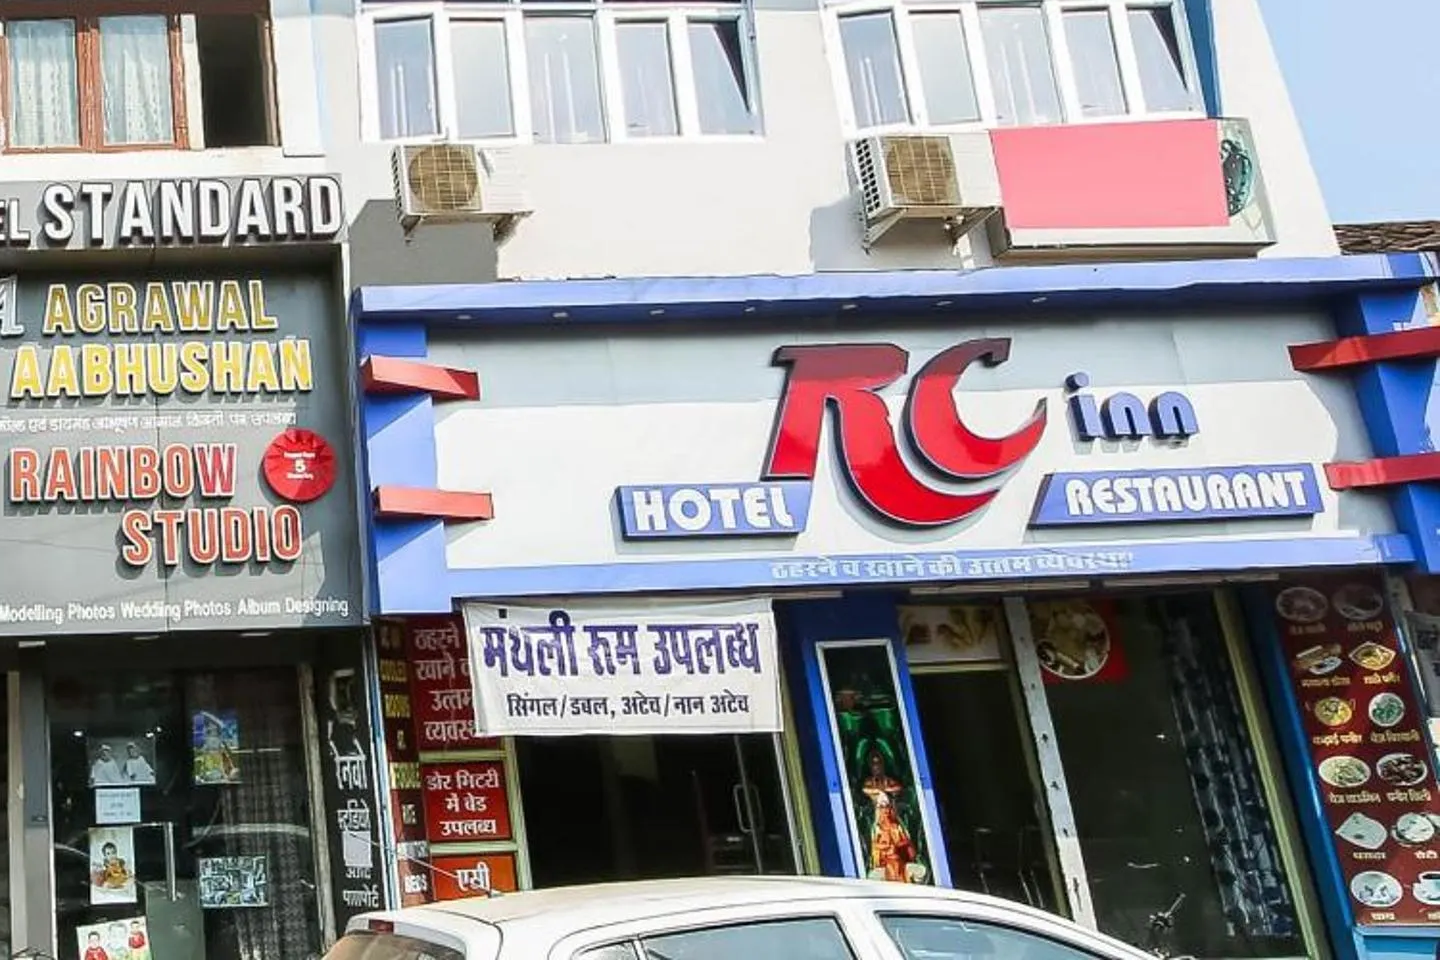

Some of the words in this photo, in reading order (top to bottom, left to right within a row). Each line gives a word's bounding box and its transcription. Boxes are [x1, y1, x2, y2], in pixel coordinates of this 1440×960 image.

[42, 178, 343, 241] STANDARD
[42, 279, 279, 334] AGRAWAL
[10, 339, 313, 399] AABHUSHAN
[1064, 372, 1200, 442] inn
[761, 338, 1048, 529] RC
[10, 443, 236, 504] RAINBOW
[1066, 471, 1310, 516] RESTAURANT
[631, 486, 795, 532] HOTEL
[122, 504, 304, 567] STUDIO
[771, 555, 838, 579] ठहरने
[864, 554, 925, 578] खाने
[928, 553, 962, 577] की
[67, 601, 116, 622] Photos
[120, 600, 182, 622] Wedding
[184, 598, 232, 619] Photos
[237, 597, 281, 616] Album
[285, 596, 350, 618] Designing
[413, 621, 460, 651] ठहरने
[647, 622, 762, 675] उपलब्ध
[414, 651, 456, 681] खाने
[710, 688, 750, 715] अटेच
[439, 819, 497, 837] उपलब्ध
